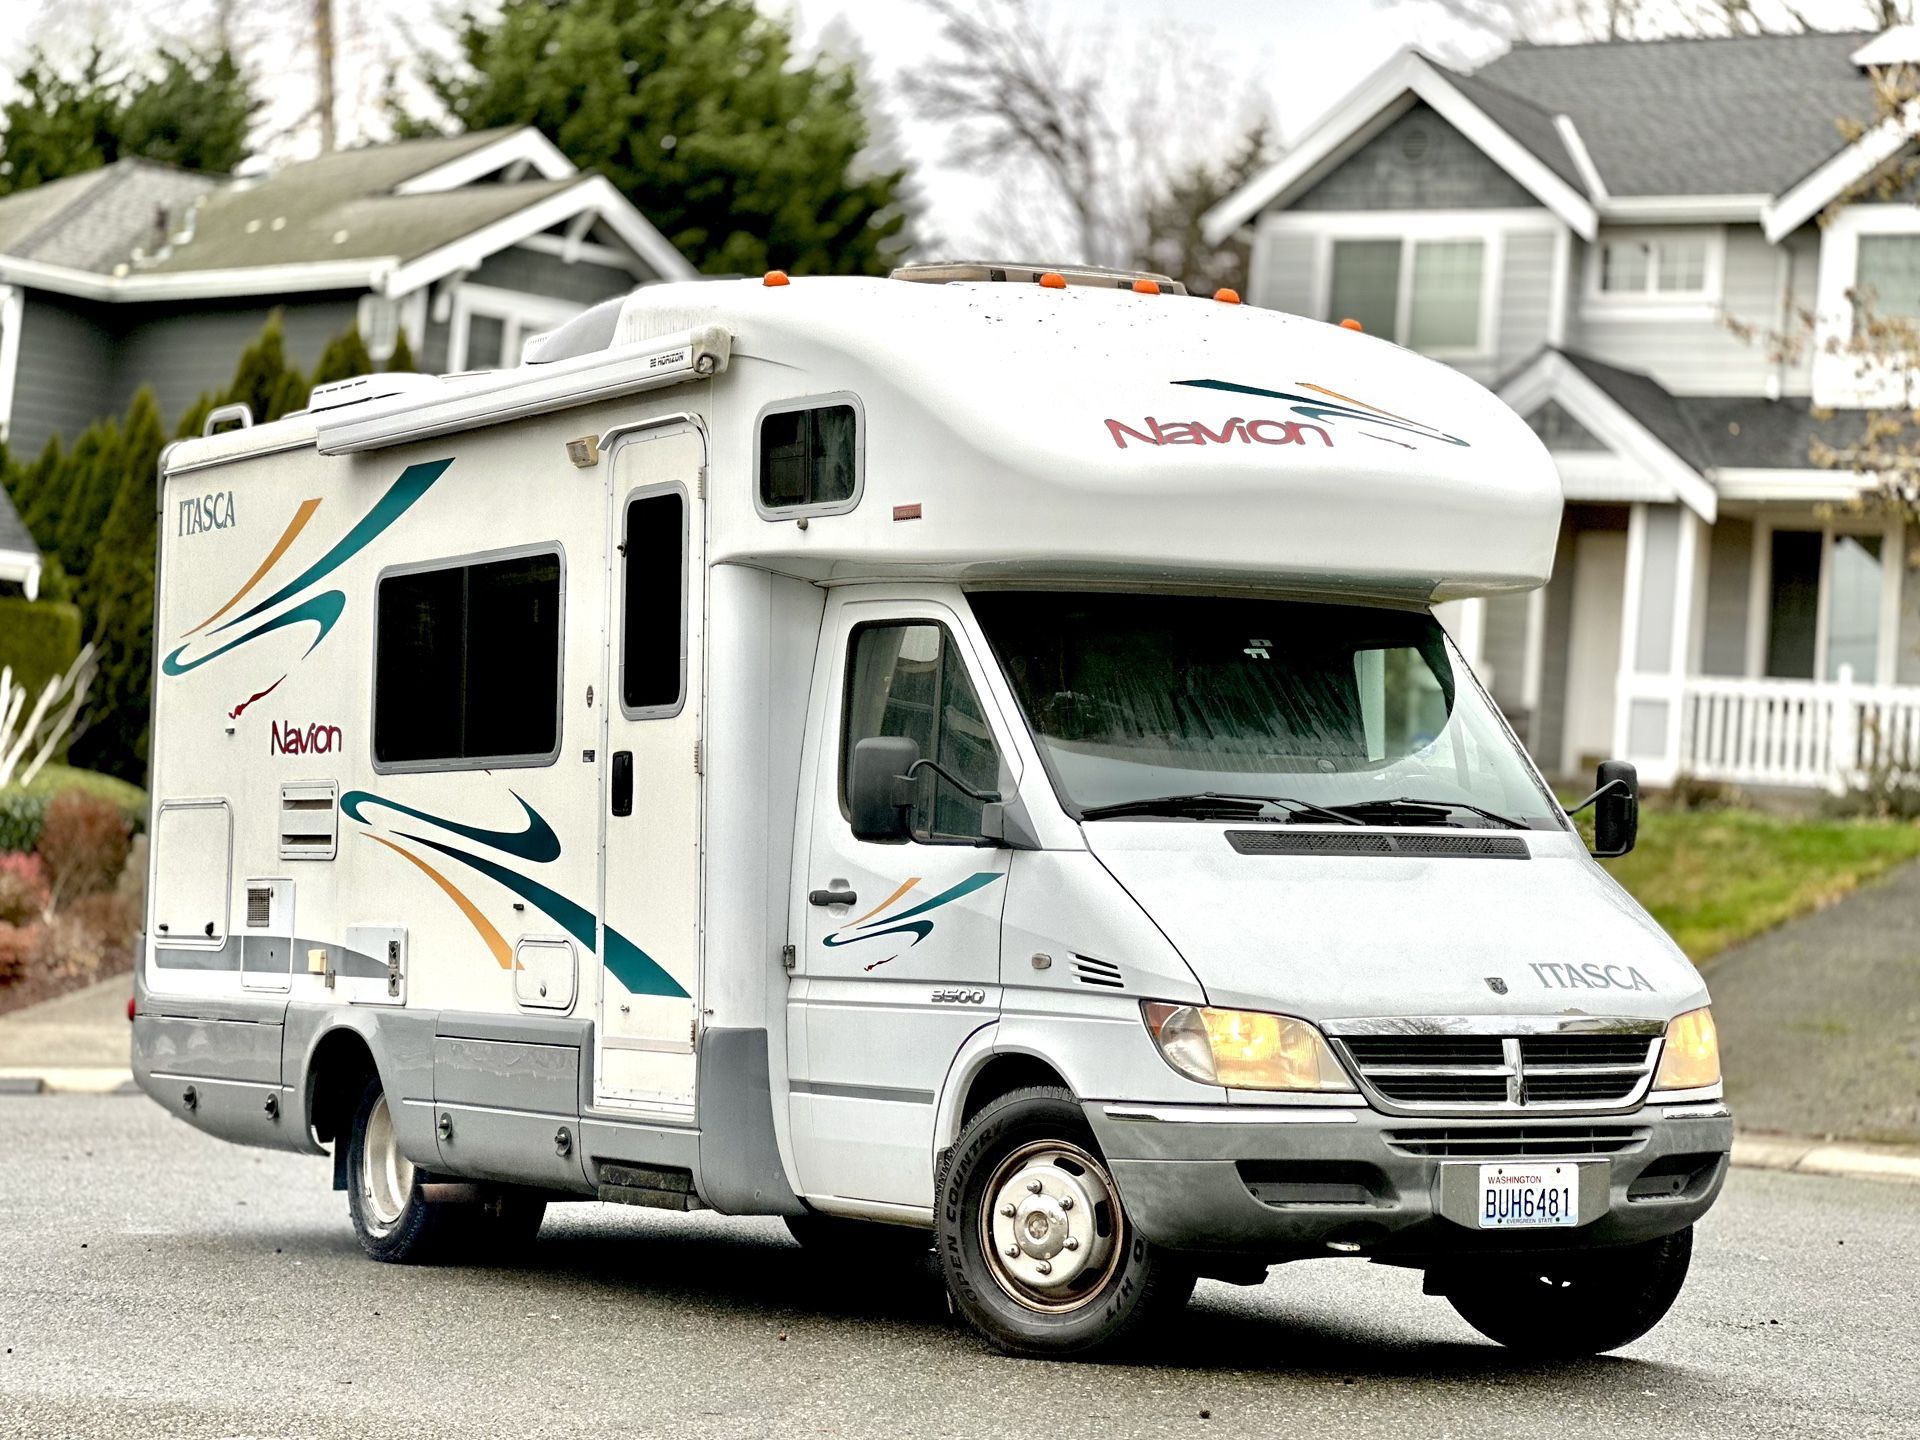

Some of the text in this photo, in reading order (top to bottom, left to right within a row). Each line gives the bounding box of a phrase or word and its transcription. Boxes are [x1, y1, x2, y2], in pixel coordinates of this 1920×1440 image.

[1104, 417, 1334, 448] Navion
[178, 490, 235, 536] ITASCA
[271, 719, 343, 756] Navion
[1528, 963, 1658, 993] ITASCA
[932, 988, 986, 1005] 3500
[1487, 1176, 1542, 1185] WASHINGTON
[1486, 1188, 1569, 1218] BUH6481
[946, 1234, 978, 1304] OPEN
